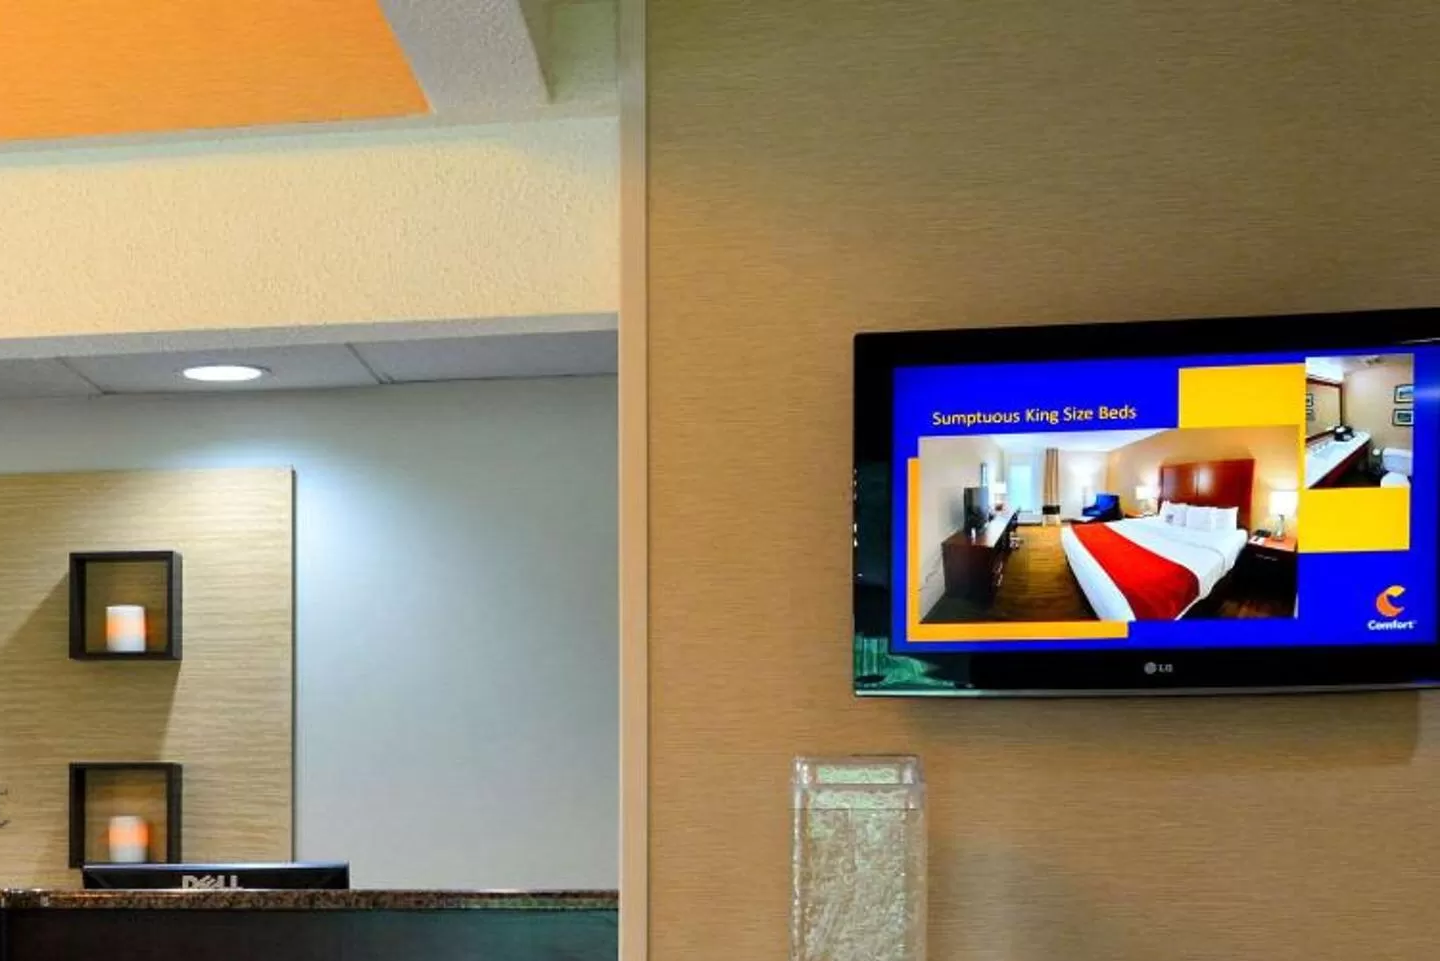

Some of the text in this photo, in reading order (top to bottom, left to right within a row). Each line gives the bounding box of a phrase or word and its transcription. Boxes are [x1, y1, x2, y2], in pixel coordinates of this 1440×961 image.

[932, 404, 1137, 428] Sumptuous King Size Beds
[1367, 619, 1415, 632] Comfort
[181, 874, 245, 889] DELL
